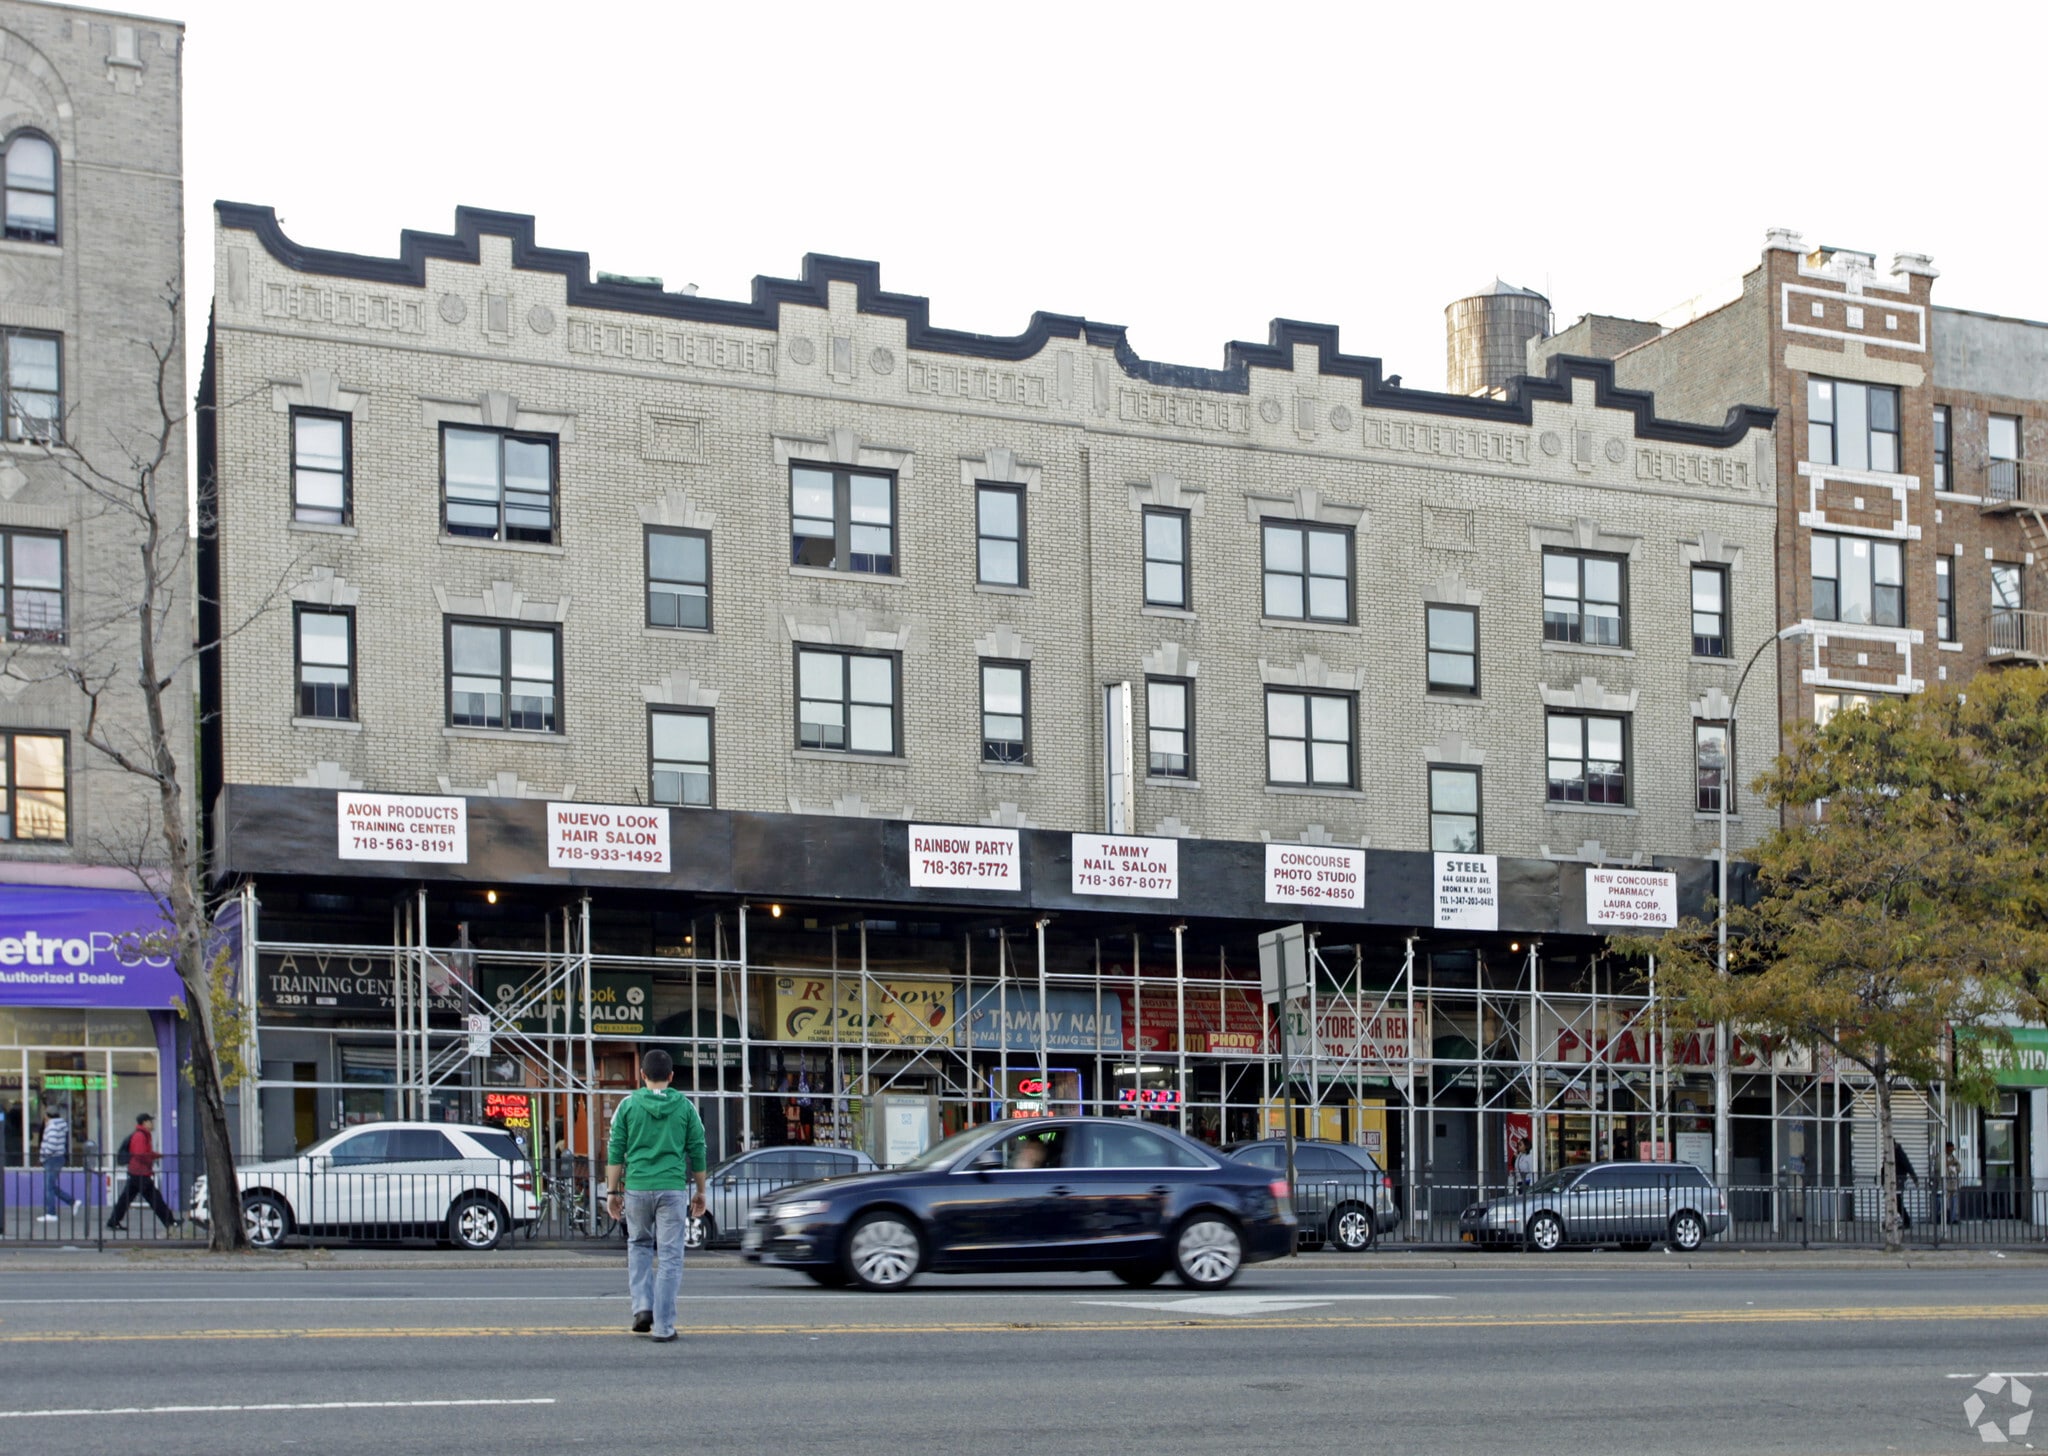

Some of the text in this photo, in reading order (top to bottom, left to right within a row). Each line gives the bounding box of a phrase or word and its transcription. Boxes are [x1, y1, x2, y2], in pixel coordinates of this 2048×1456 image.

[347, 803, 458, 820] AVON PRODUCTS
[350, 820, 456, 835] TRAINING CENTER
[558, 812, 658, 829] NUEVO LOOK
[353, 837, 454, 852] 718-563-8191
[562, 829, 656, 845] HAIR SALON
[915, 838, 1013, 855] RAINBOW PARTY
[1102, 845, 1149, 857] TAMMY
[557, 847, 662, 863] 718-933-1492
[1281, 853, 1350, 868] CONCOURSE
[922, 860, 1008, 877] 718-367-5772
[1083, 859, 1167, 873] NAIL SALON
[1446, 861, 1487, 873] STEEL
[1079, 874, 1171, 889] 718-367-8077
[1274, 868, 1356, 883] PHOTO STUDIO
[1594, 875, 1669, 886] NEW CONCOURSE
[1276, 884, 1355, 899] 718-562-4850
[1608, 887, 1654, 897] PHARMACY
[1604, 900, 1661, 910] LAURA CORP.
[0, 931, 171, 968] etroPCS
[279, 951, 397, 976] AVO
[0, 972, 126, 984] Authorized Dealer
[270, 974, 352, 994] TRAINING
[276, 994, 308, 1005] 2391
[579, 1006, 644, 1021] SALON
[989, 1009, 1063, 1032] TAMMY
[1316, 1016, 1418, 1041] STORE FOR RENT
[980, 1031, 1013, 1043] NAIS
[1169, 1033, 1256, 1052] POTO PHOTO
[2017, 1049, 2048, 1070] VID
[487, 1093, 526, 1106] SALON
